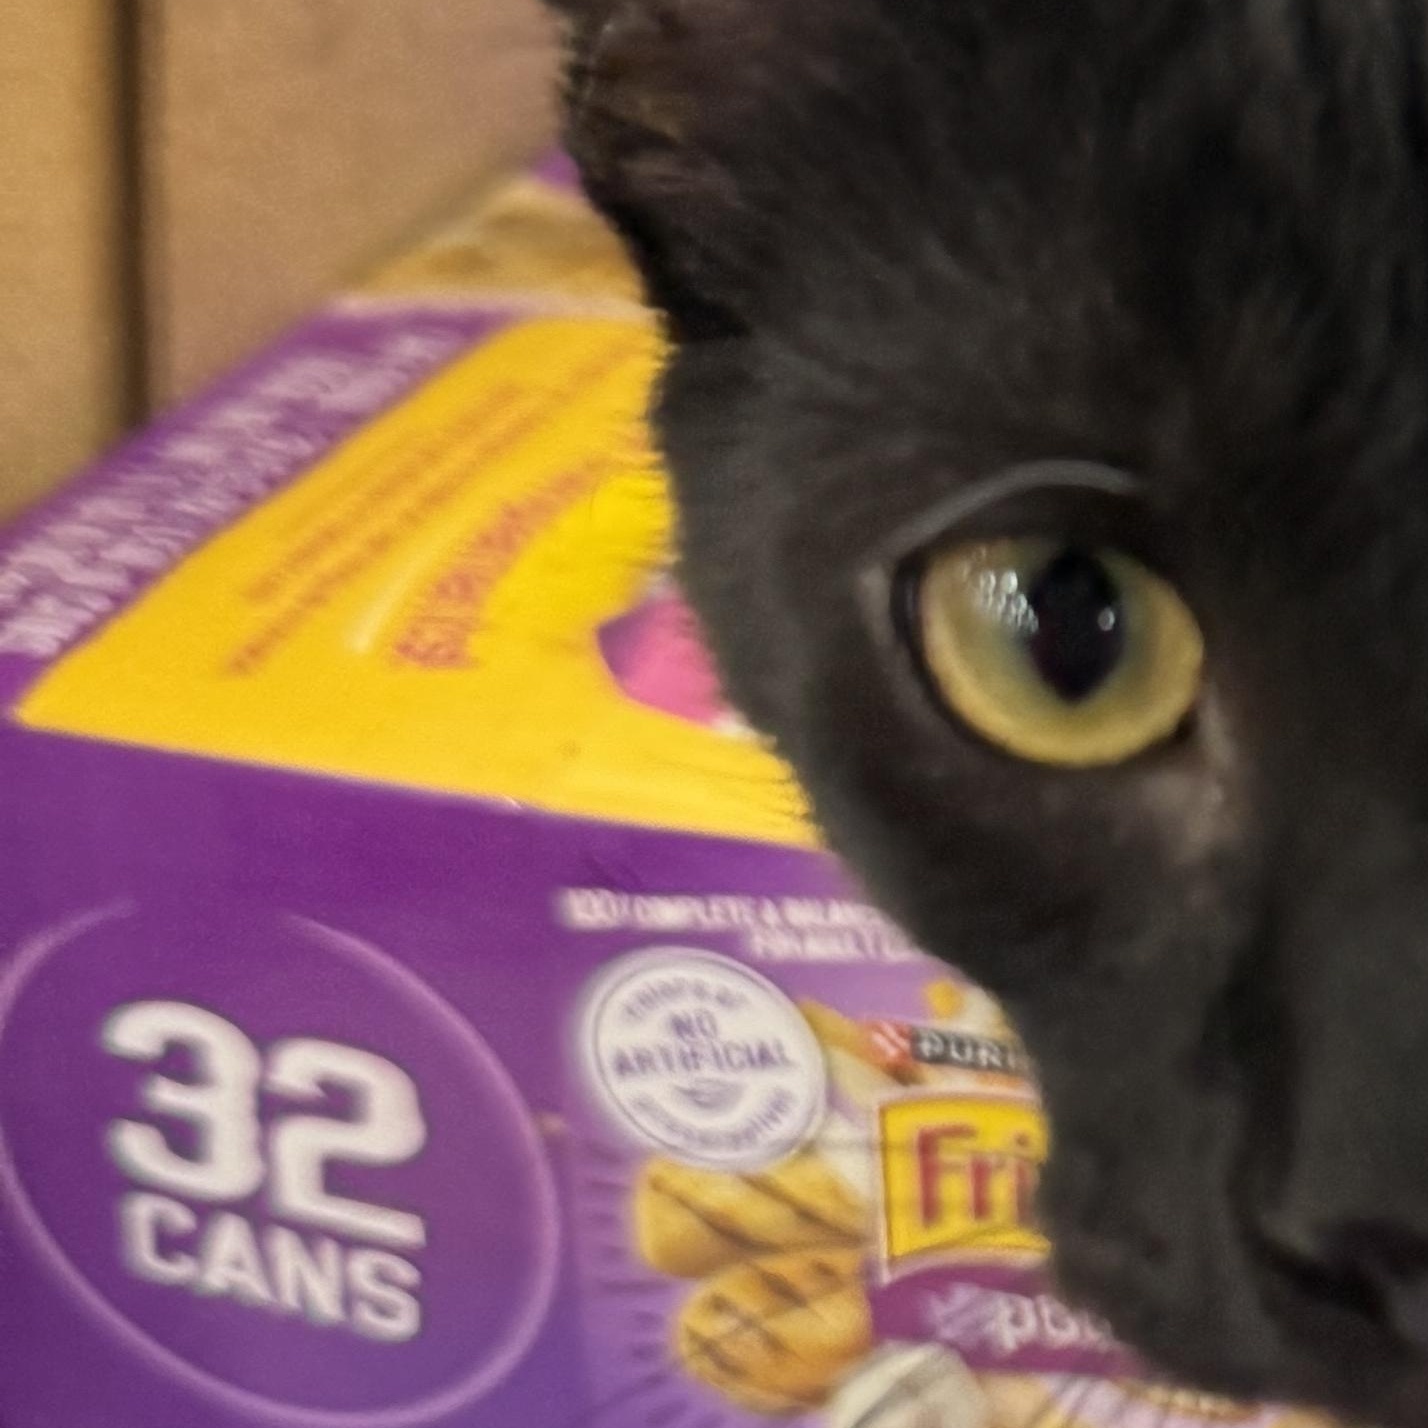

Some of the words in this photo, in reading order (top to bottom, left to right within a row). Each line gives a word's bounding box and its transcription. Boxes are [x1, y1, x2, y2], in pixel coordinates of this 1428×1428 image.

[613, 1038, 800, 1077] ARTIFICIAL
[670, 1009, 719, 1042] NO
[104, 1000, 427, 1249] 32
[120, 1190, 422, 1343] CANS
